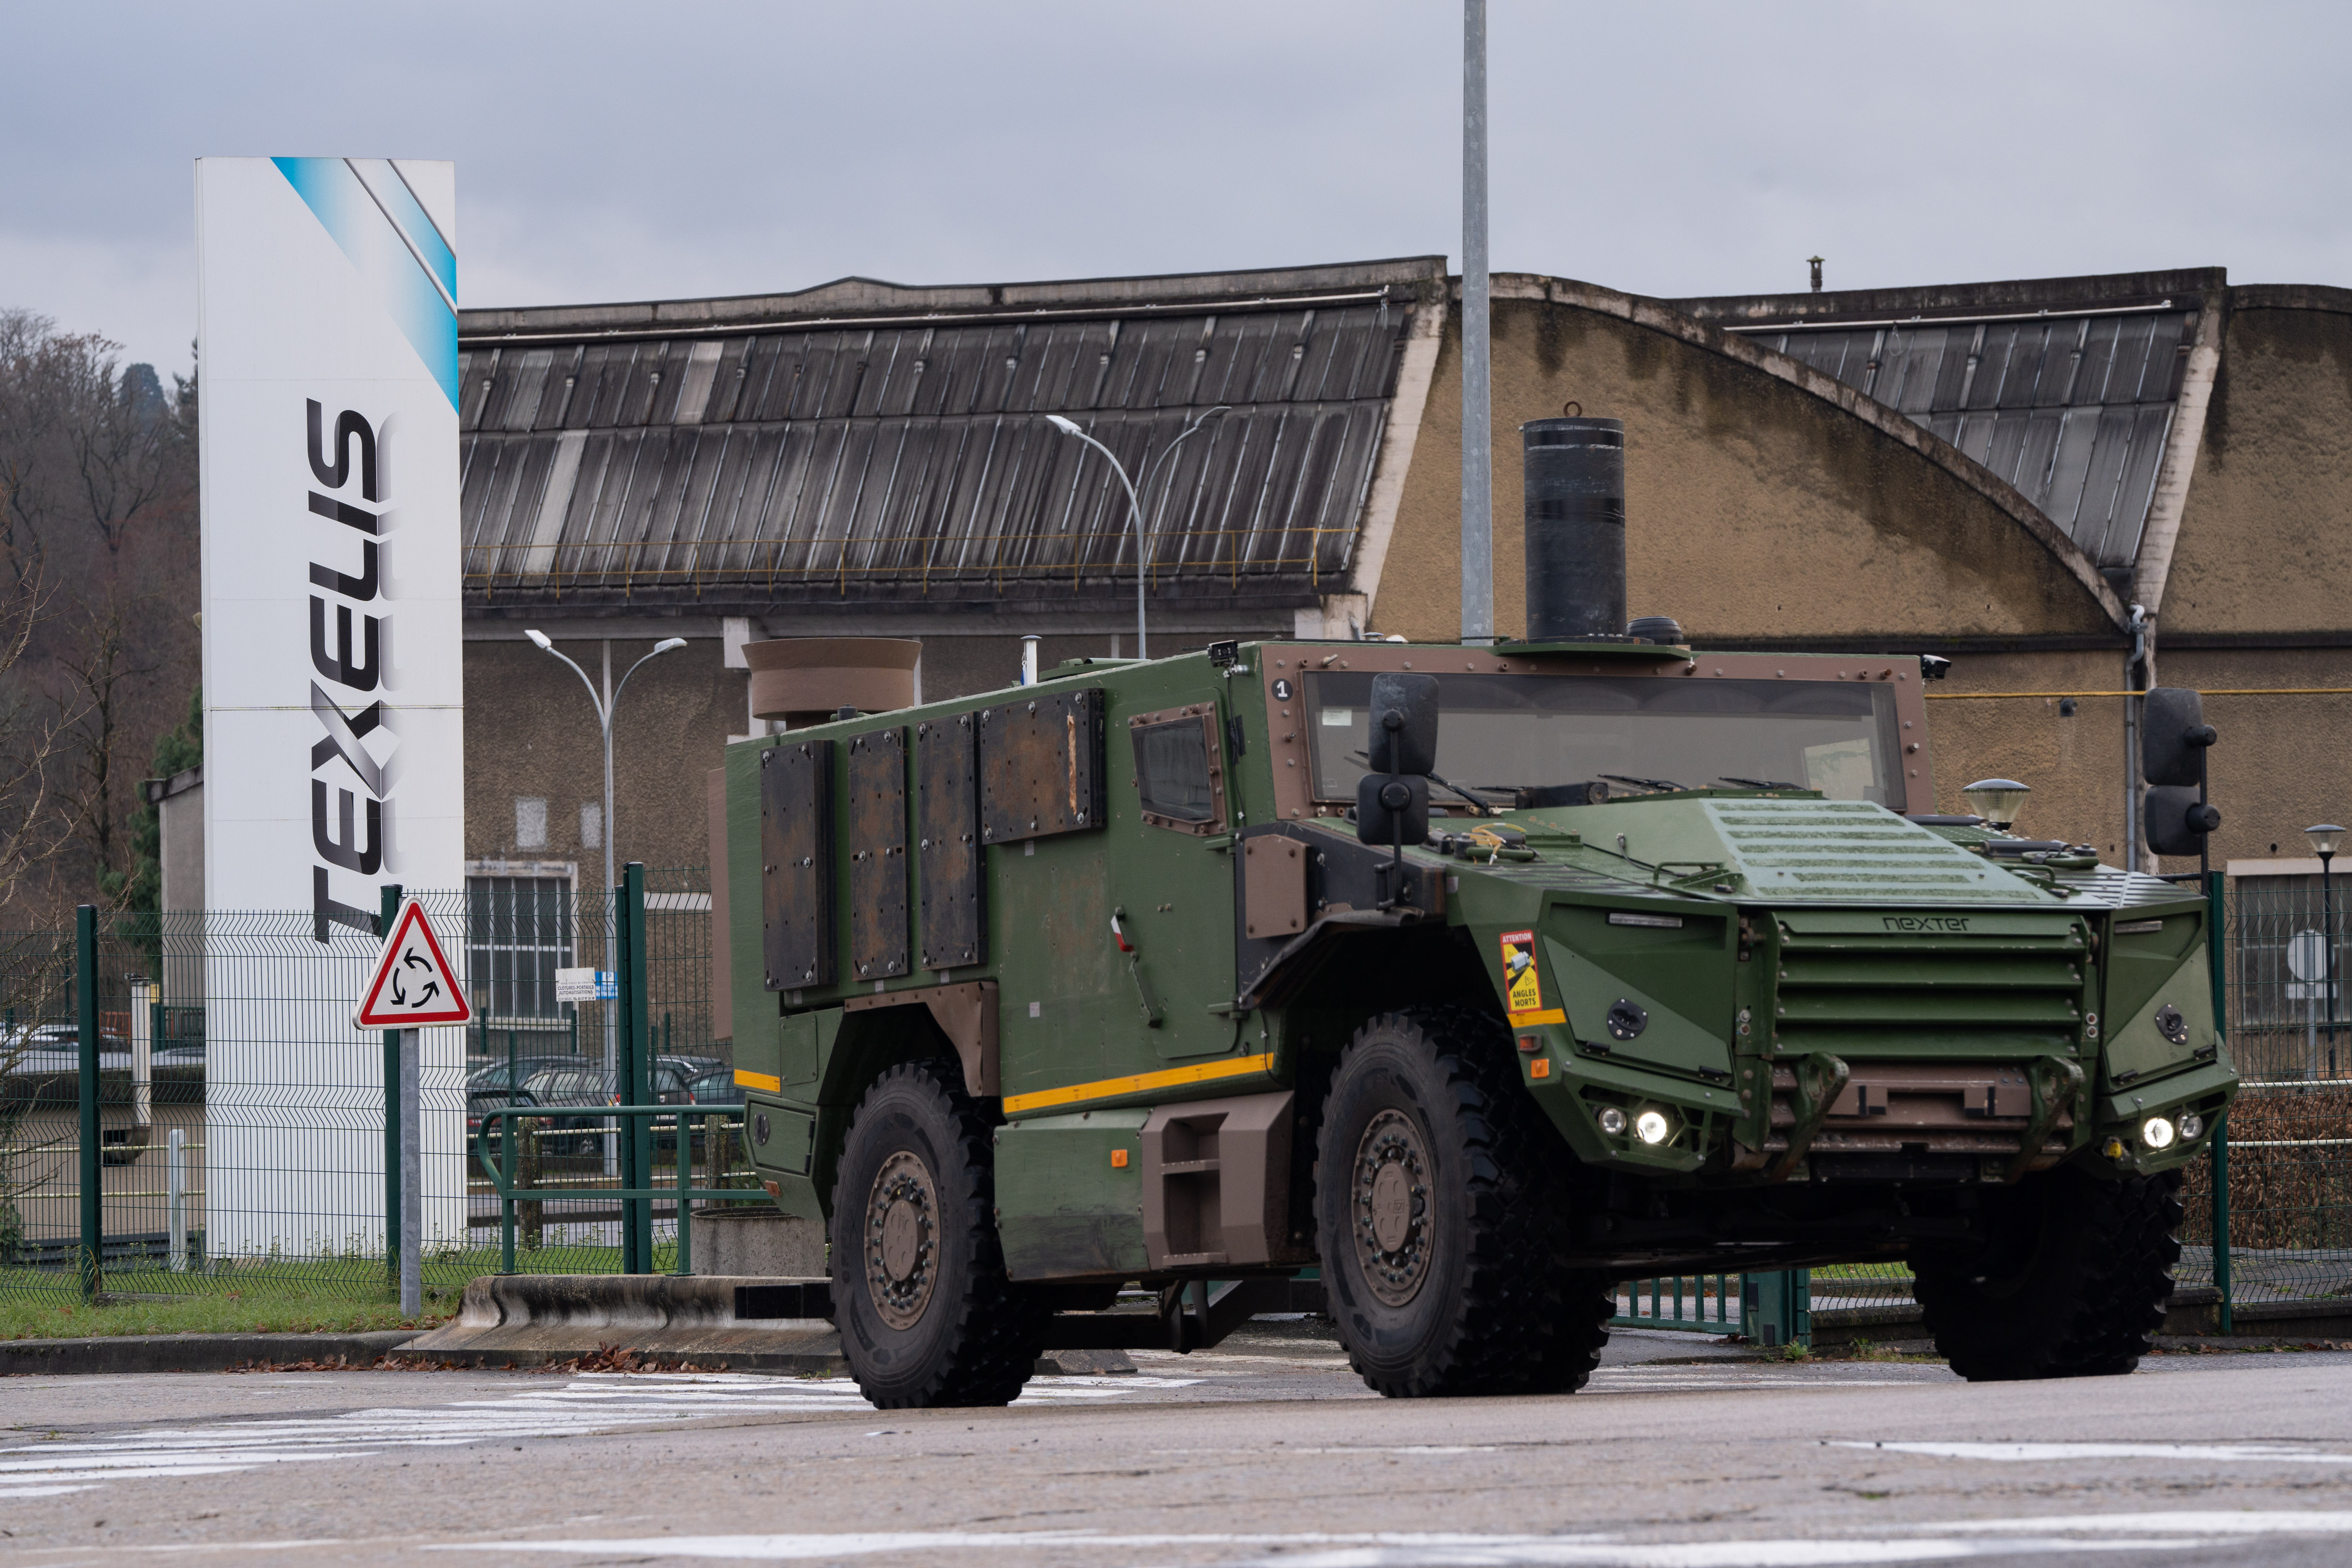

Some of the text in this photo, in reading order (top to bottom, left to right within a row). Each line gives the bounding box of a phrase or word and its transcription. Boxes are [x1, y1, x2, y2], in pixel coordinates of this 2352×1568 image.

[306, 397, 382, 945] TEXELIS
[1277, 681, 1288, 697] 1
[1502, 932, 1532, 943] ATTENTION
[1513, 988, 1536, 998] ANGLES
[1515, 997, 1536, 1007] MORTS
